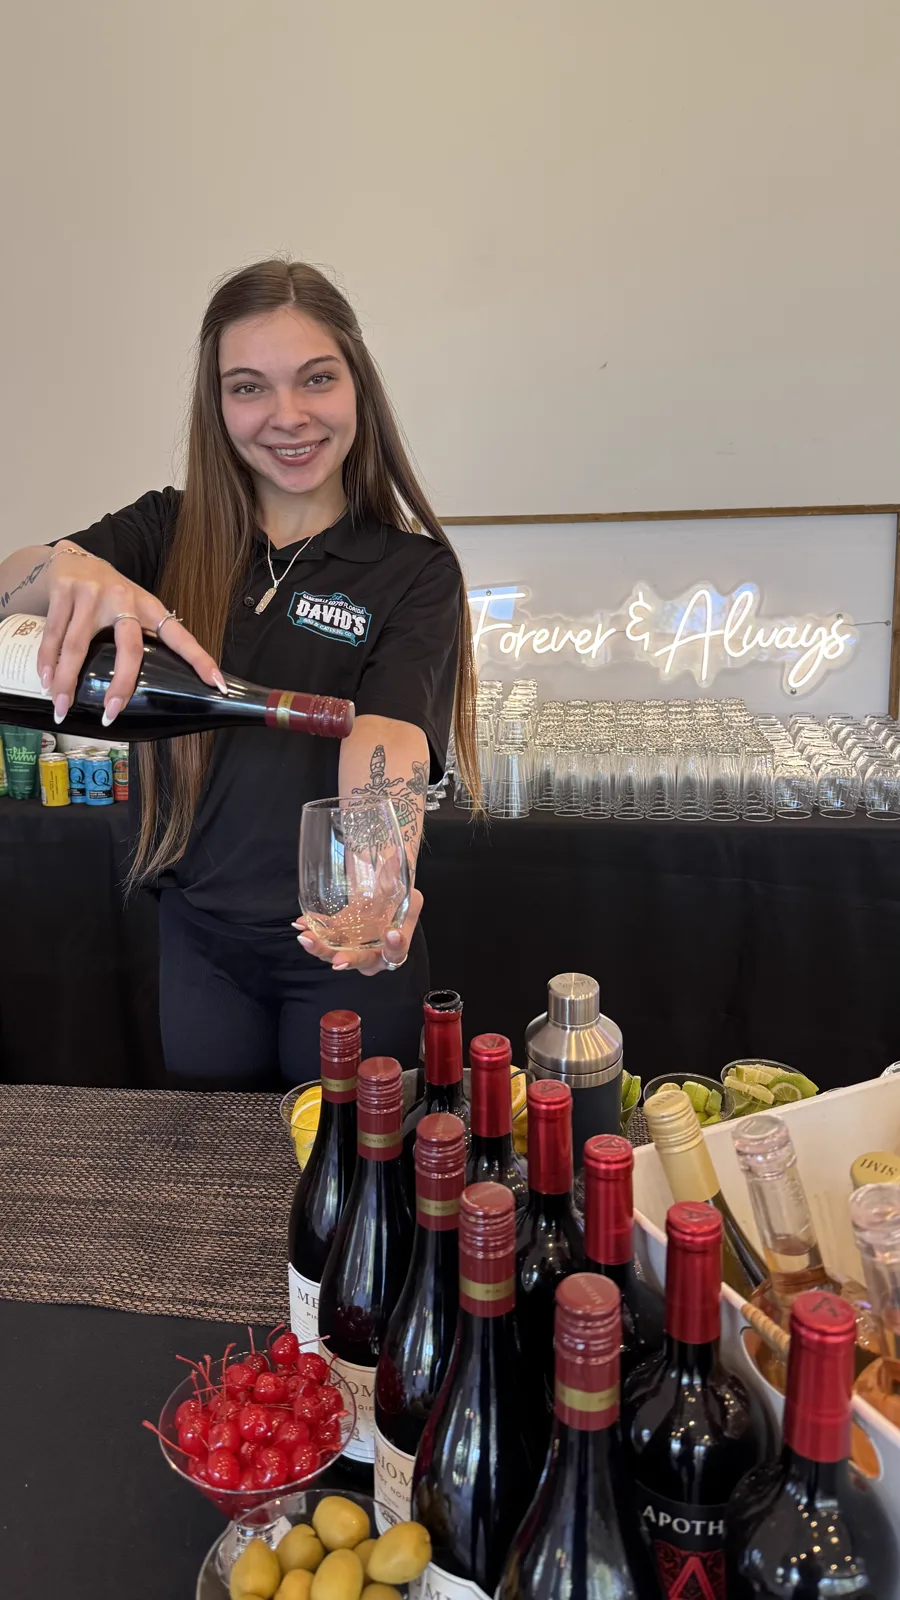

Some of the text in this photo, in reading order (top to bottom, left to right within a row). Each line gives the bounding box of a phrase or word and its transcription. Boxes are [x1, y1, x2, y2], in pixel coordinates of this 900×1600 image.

[295, 599, 366, 636] DAVID'S
[468, 588, 852, 689] Forever & Always
[92, 769, 113, 787] Q
[296, 1285, 320, 1310] ME
[642, 1505, 725, 1537] APOTH
